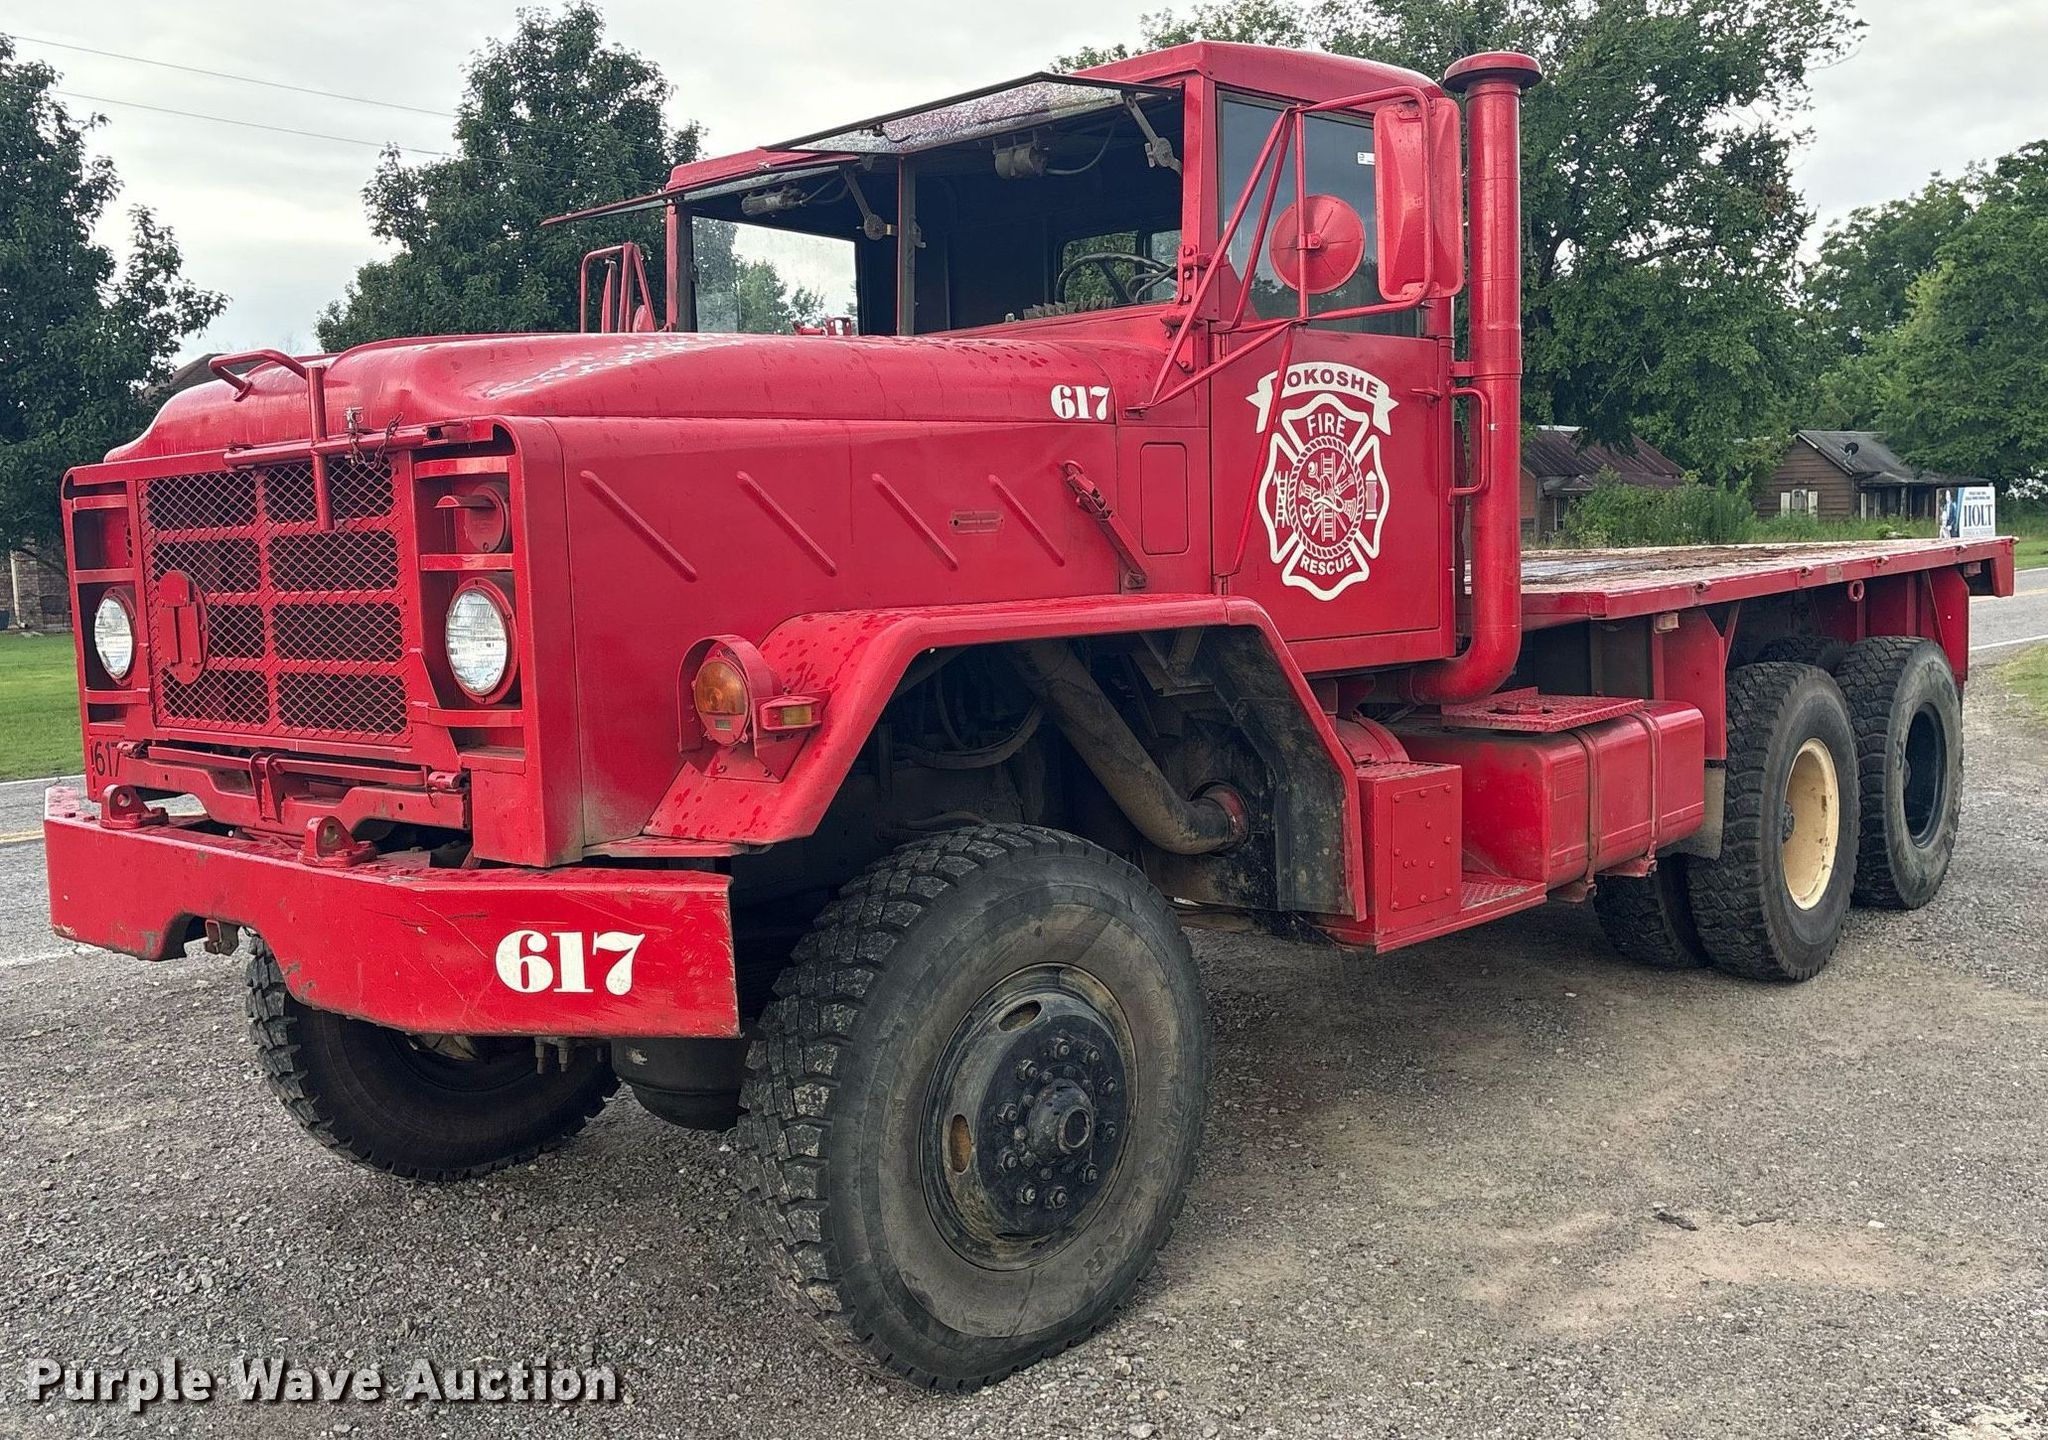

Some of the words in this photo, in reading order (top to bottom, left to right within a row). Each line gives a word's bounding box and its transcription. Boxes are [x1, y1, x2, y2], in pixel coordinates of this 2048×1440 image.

[1282, 368, 1379, 399] OKOSHE
[1050, 384, 1110, 421] 617
[1306, 412, 1347, 438] FIRE
[1963, 504, 1993, 528] HOLT
[1300, 552, 1354, 576] RESCUE
[94, 741, 121, 778] 617
[495, 929, 646, 996] 617
